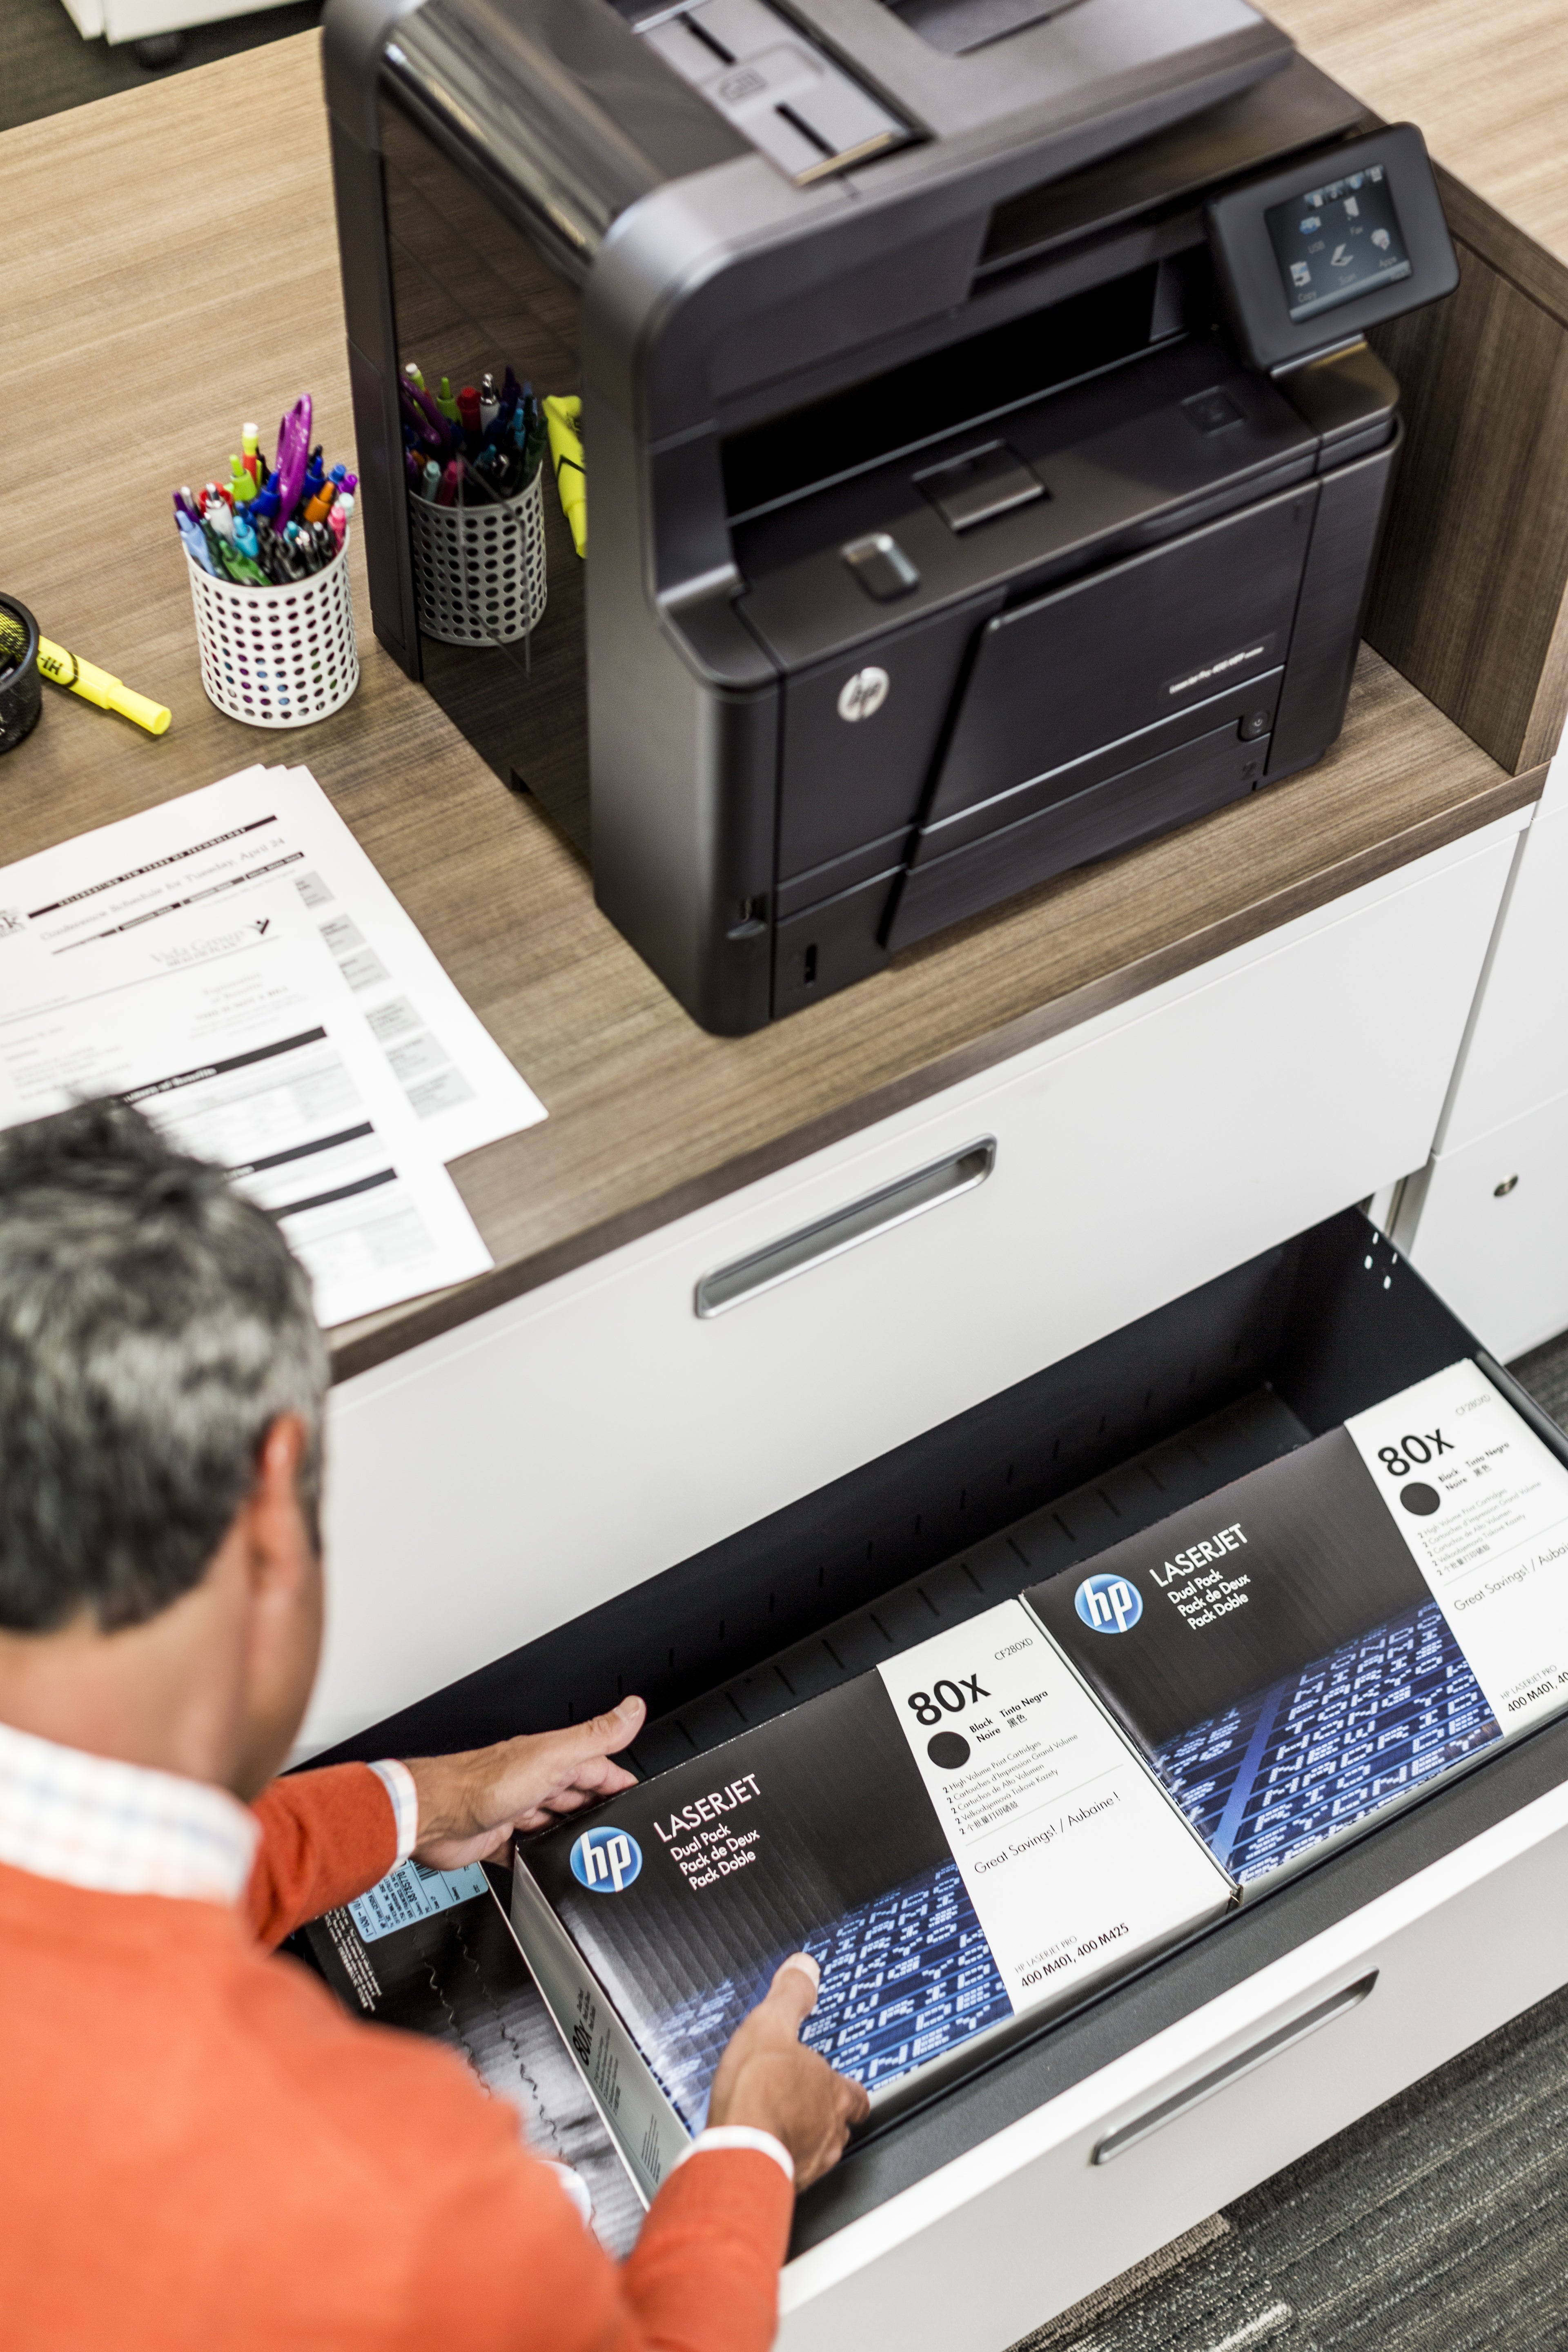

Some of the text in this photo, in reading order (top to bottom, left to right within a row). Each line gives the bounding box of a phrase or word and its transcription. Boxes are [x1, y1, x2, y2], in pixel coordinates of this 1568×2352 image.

[1438, 1443, 1510, 1483] Black Tinta Negra
[1445, 1478, 1467, 1490] Noire
[1423, 1524, 1439, 1535] High
[1440, 1513, 1462, 1527] Volume
[1475, 1488, 1507, 1506] Cartridges
[1428, 1525, 1463, 1545] Cartouches
[1519, 1481, 1541, 1495] Volume
[1433, 1536, 1464, 1554] Cartuchos
[1487, 1510, 1510, 1525] Volumen
[1149, 1522, 1248, 1588] LASERJET
[1081, 1578, 1133, 1633] hp
[1167, 1568, 1224, 1604] Dual Pack
[1176, 1574, 1252, 1617] Pack de Deux
[1186, 1592, 1249, 1630] Pack Doble
[1454, 1590, 1486, 1611] Great
[1484, 1564, 1528, 1594] Savings!
[1530, 1558, 1536, 1572] /
[994, 1638, 1033, 1660] CF280XD
[1293, 1627, 1438, 1704] MIAMI
[1285, 1655, 1443, 1735] TOKYO
[1288, 1639, 1443, 1721] PARIS
[1500, 1665, 1557, 1700] HP LASERJET PRO
[1508, 1696, 1527, 1712] 400
[1526, 1681, 1558, 1702] M401,
[969, 1691, 1049, 1733] Black Tinta Negra
[976, 1714, 1028, 1743] Noire 黑色
[1276, 1685, 1411, 1761] HONG
[949, 1778, 967, 1791] High
[965, 1767, 991, 1781] Volume
[991, 1757, 1007, 1769] Print
[1007, 1742, 1042, 1760] Cartridges
[953, 1780, 991, 1800] Cartouches
[1031, 1744, 1054, 1760] Grand
[1052, 1735, 1078, 1748] Volume
[1254, 1764, 1382, 1834] RIO
[1411, 1708, 1494, 1755] DE
[1262, 1691, 1478, 1807] MADRID
[1268, 1719, 1376, 1784] NEW
[653, 1773, 761, 1843] LASERJET
[957, 1792, 991, 1810] Cartuchos
[1002, 1779, 1016, 1789] Alto
[1015, 1764, 1045, 1780] Volumen
[1011, 1780, 1036, 1795] Tiskové
[1035, 1769, 1058, 1783] Kazety
[1245, 1728, 1481, 1862] SYDNEY
[579, 1831, 632, 1893] hp
[670, 1822, 732, 1862] Dual Pack
[679, 1829, 761, 1876] Pack de Deux
[974, 1851, 1009, 1873] Great
[1008, 1824, 1056, 1855] Savings!
[1060, 1818, 1064, 1833] /
[1067, 1798, 1113, 1826] Aubaine
[688, 1849, 756, 1891] Pack Doble
[817, 1923, 957, 1996] OKYO
[823, 1904, 958, 1976] ARIS
[1014, 1936, 1077, 1973] HP LASERJET PRO
[1022, 1924, 1129, 1987] 400 M401, 400 M425
[808, 1963, 991, 2054] ADRID
[809, 1955, 920, 2016] ONG
[801, 1993, 879, 2043] EW
[846, 2004, 991, 2082] NEY
